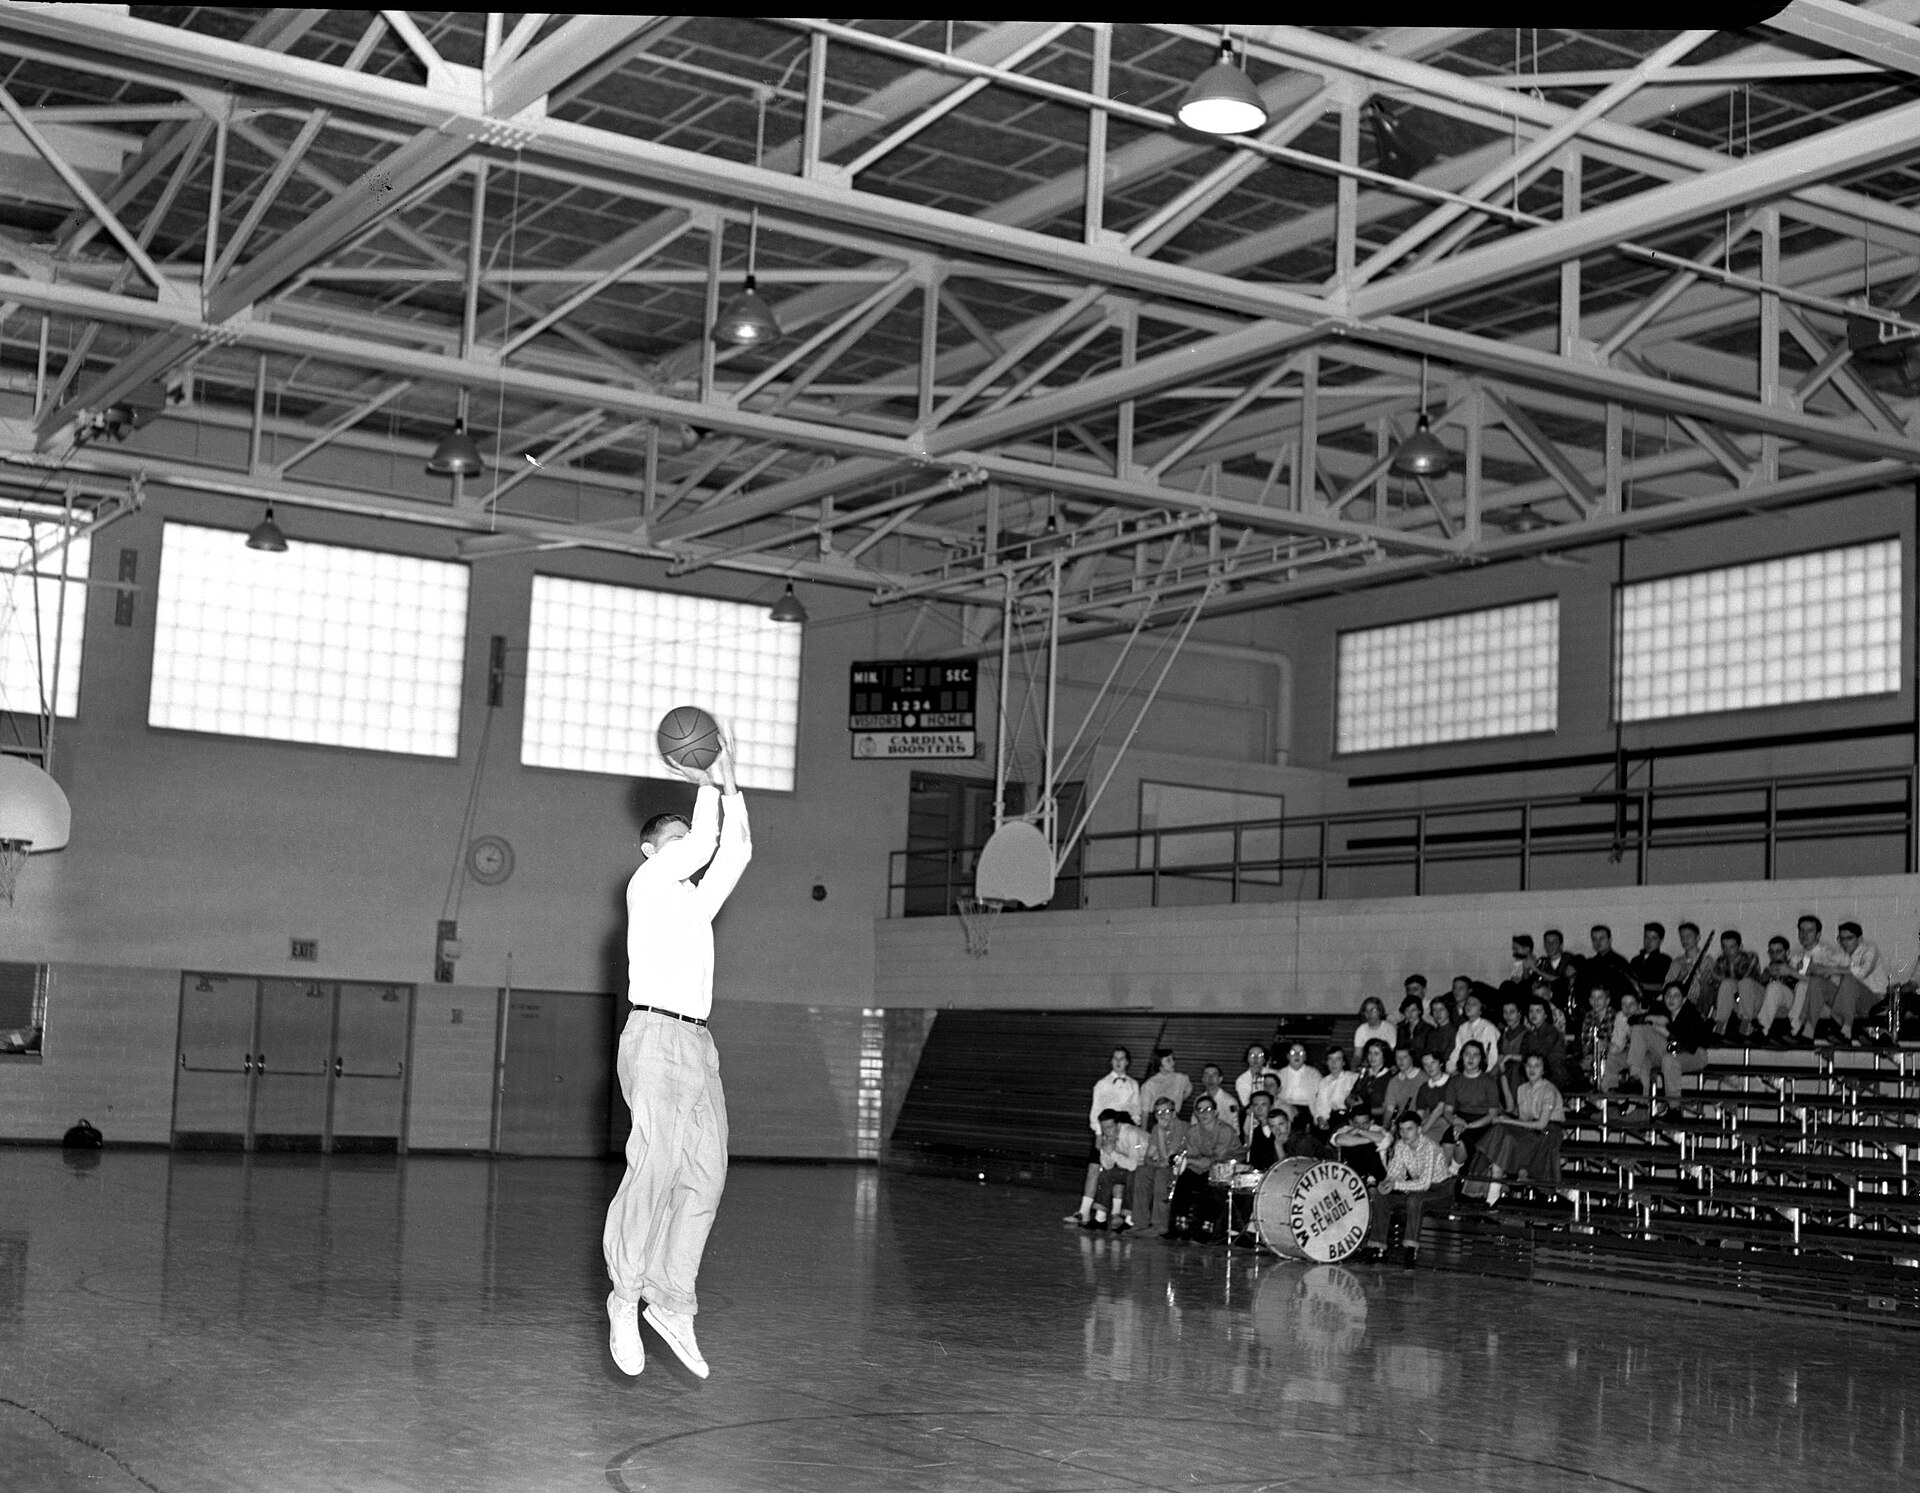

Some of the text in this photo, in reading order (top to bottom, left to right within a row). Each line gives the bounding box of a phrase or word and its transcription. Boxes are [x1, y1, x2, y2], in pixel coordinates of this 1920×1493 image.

[927, 714, 969, 727] HOME
[890, 735, 962, 745] CARDINAL
[888, 744, 966, 754] BOOSTERS
[291, 941, 317, 958] EXIT
[1310, 1189, 1341, 1220] HIGH
[1310, 1199, 1353, 1237] SCHOOL
[1329, 1225, 1363, 1259] BAND
